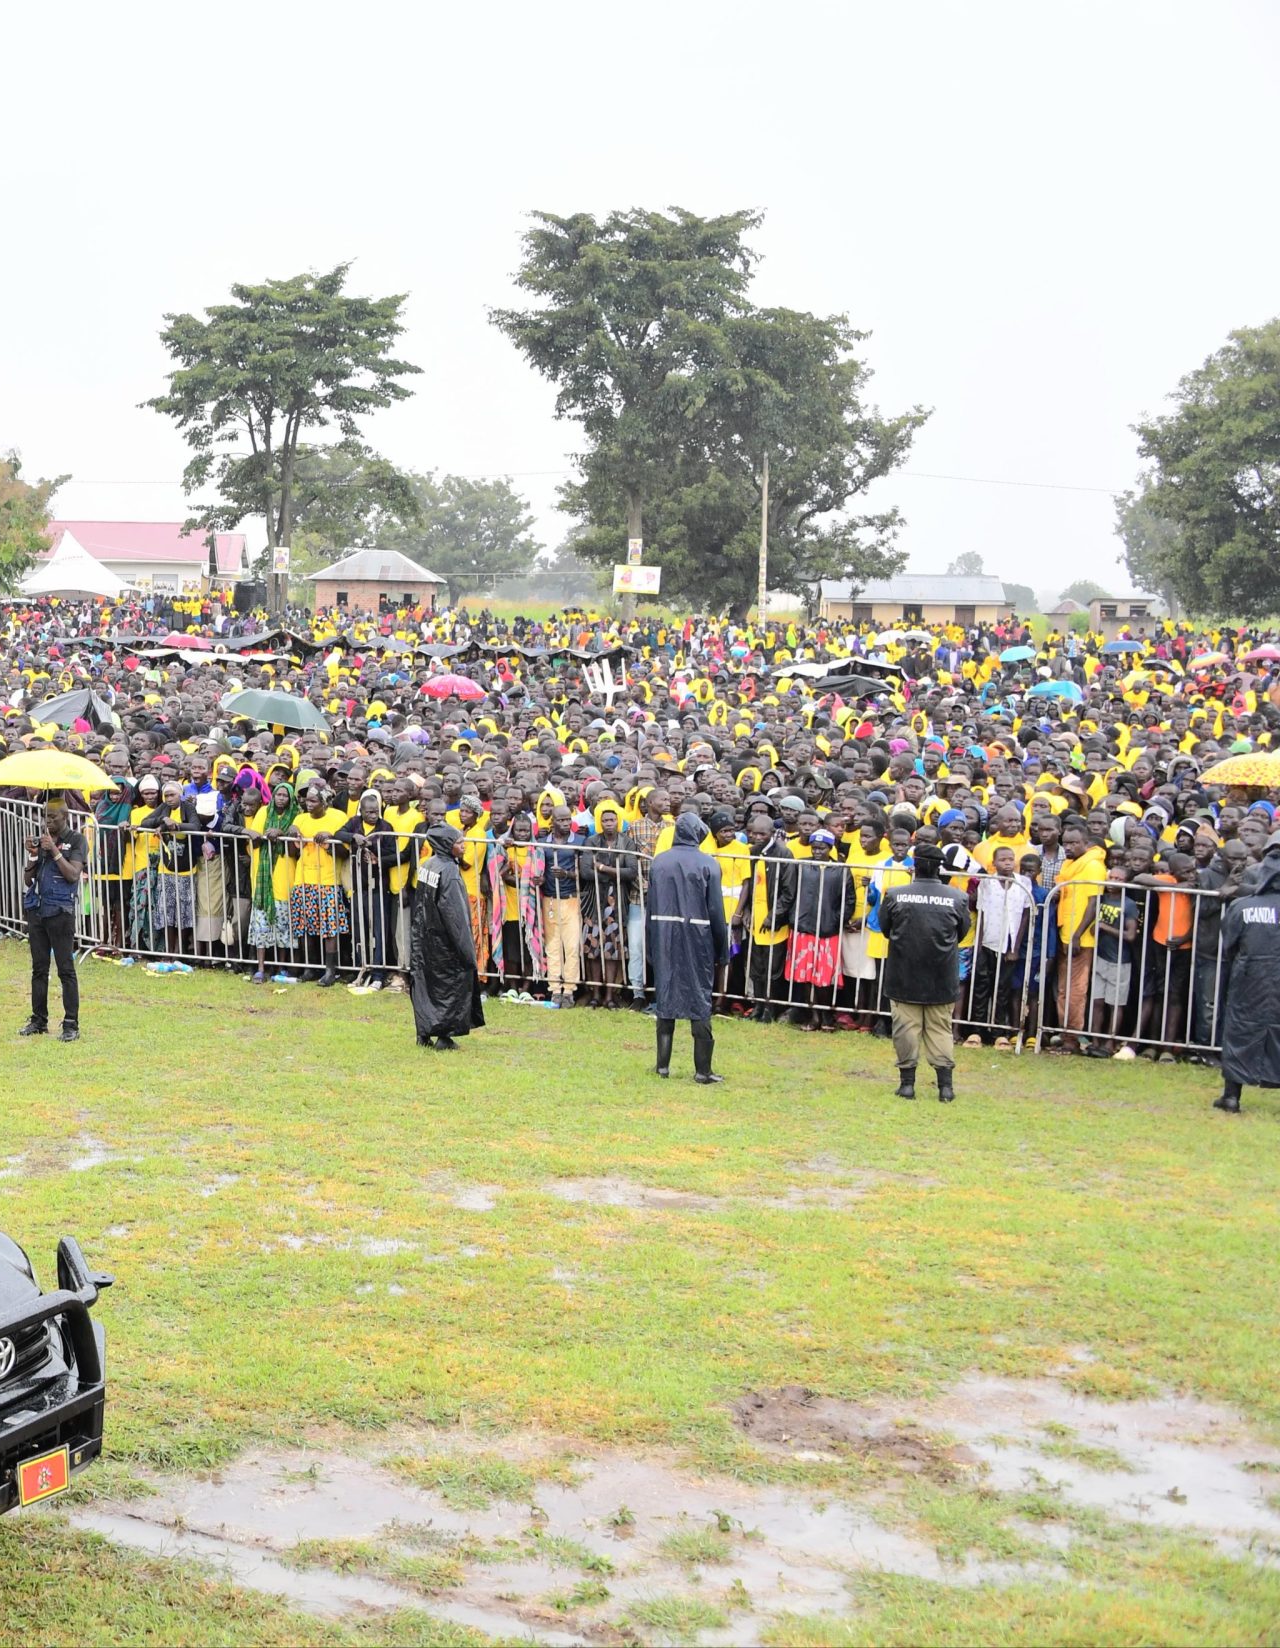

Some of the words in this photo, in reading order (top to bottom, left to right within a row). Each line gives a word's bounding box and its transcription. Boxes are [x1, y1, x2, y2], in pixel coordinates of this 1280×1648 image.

[897, 894, 928, 904] UGANDA
[929, 896, 954, 907] POLICE
[1242, 907, 1276, 924] UGANDA
